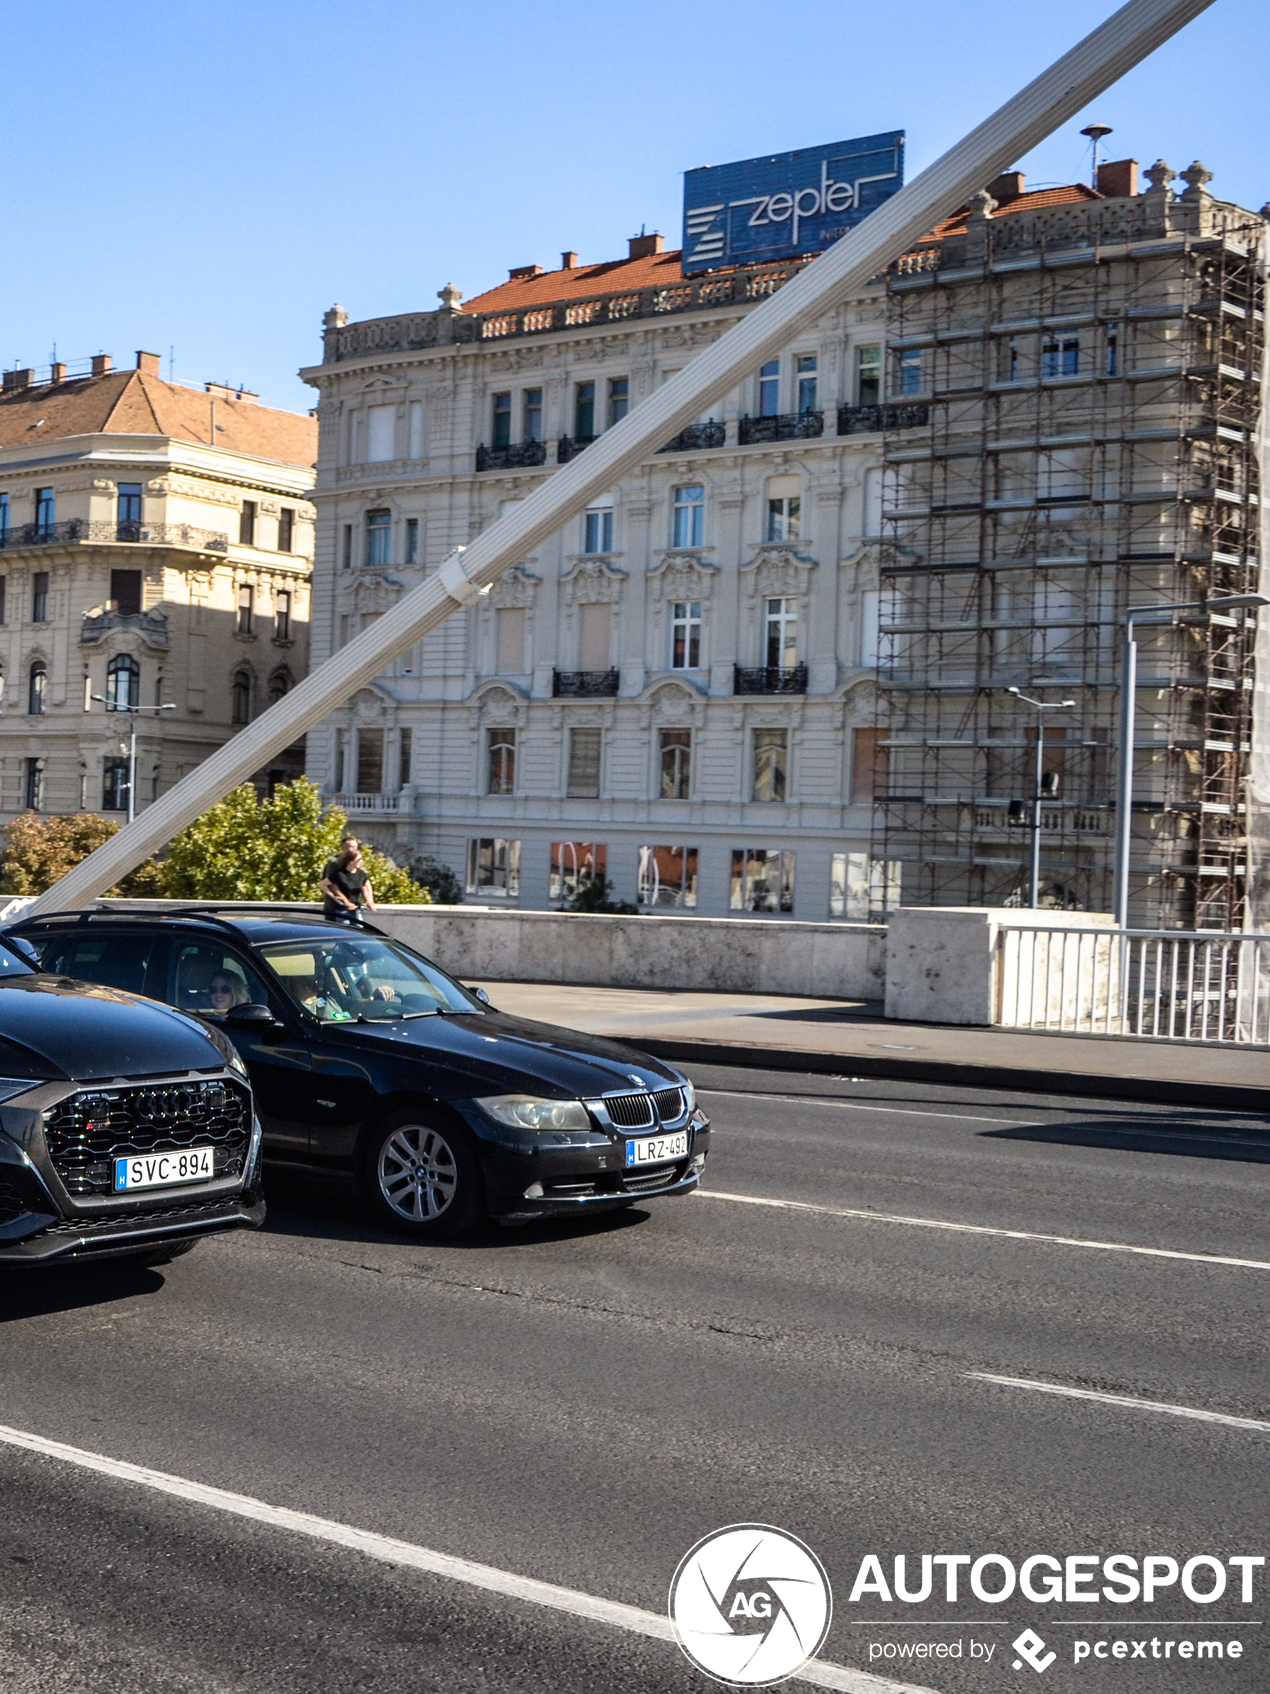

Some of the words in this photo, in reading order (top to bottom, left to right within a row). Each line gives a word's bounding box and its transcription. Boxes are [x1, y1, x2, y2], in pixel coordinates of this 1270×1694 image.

[729, 159, 898, 245] zepter
[637, 1136, 686, 1161] LRZ-492
[131, 1152, 209, 1184] SVC-894
